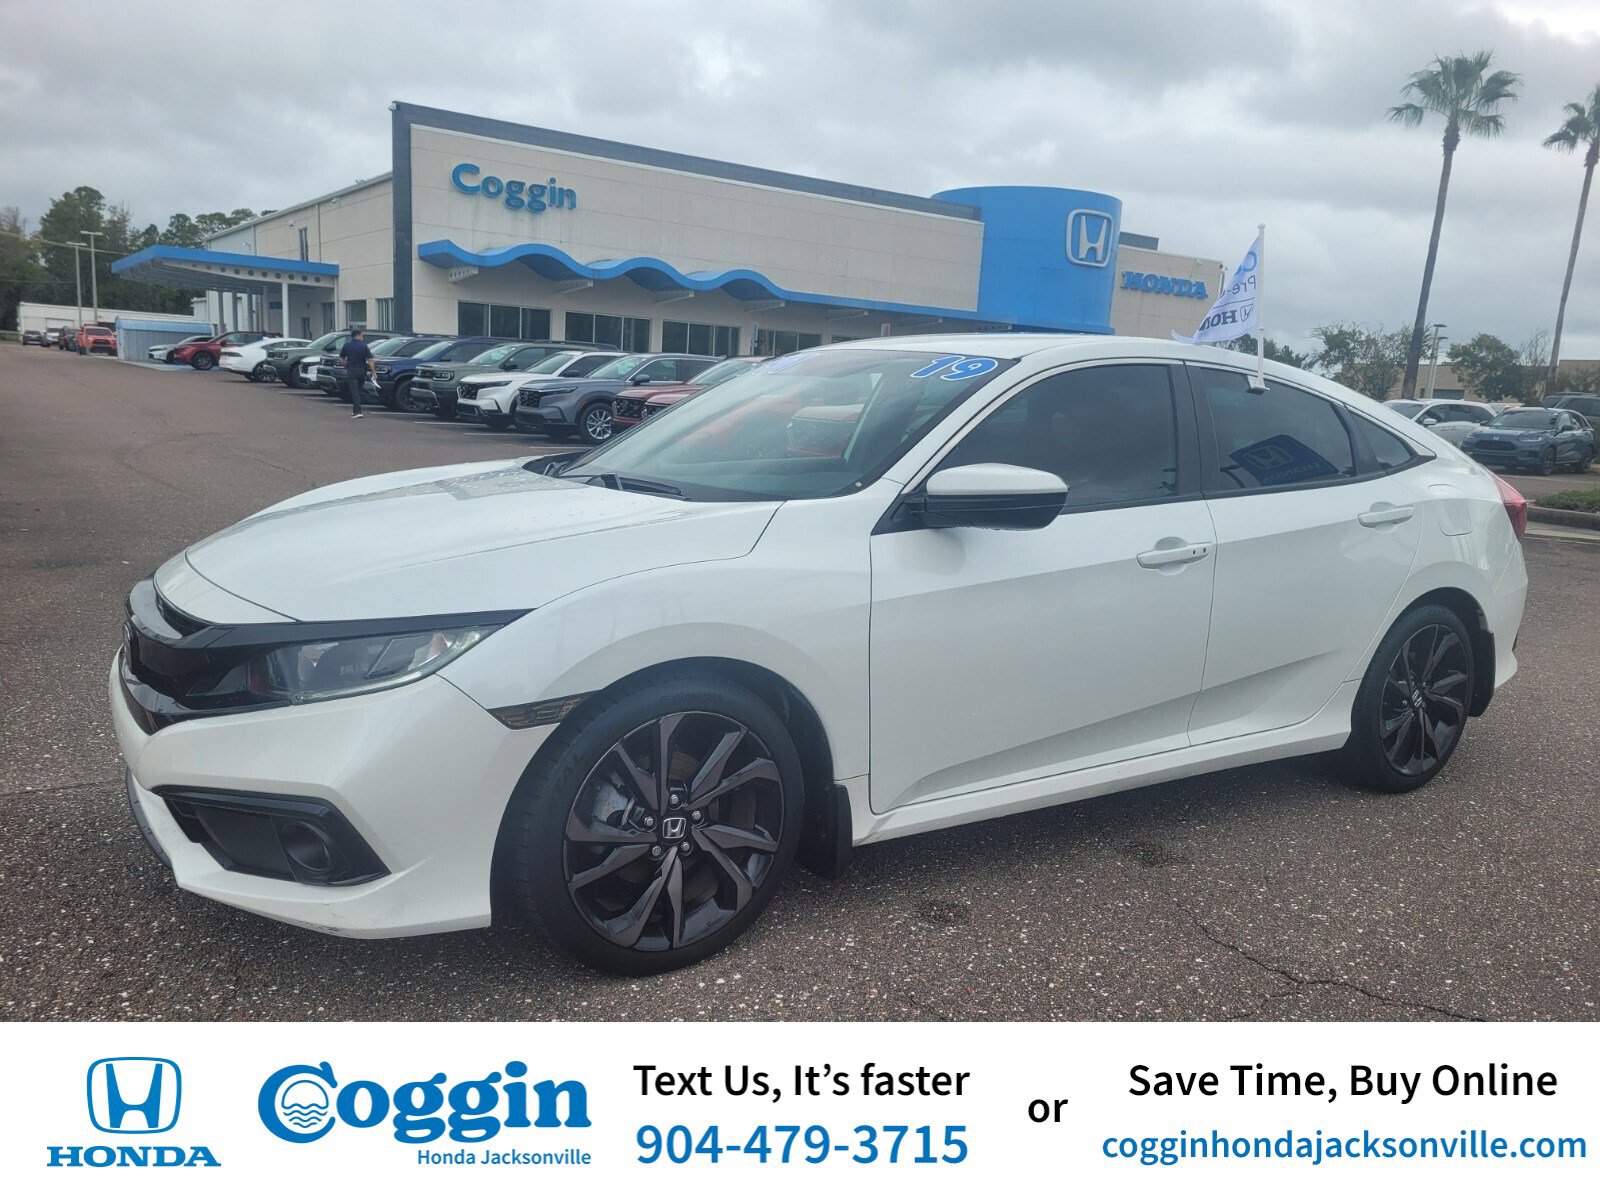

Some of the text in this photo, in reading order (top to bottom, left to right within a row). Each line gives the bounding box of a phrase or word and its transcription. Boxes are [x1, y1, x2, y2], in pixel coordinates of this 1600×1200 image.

[451, 163, 577, 212] Coggin
[1121, 271, 1208, 300] HONDA
[910, 355, 999, 382] 19
